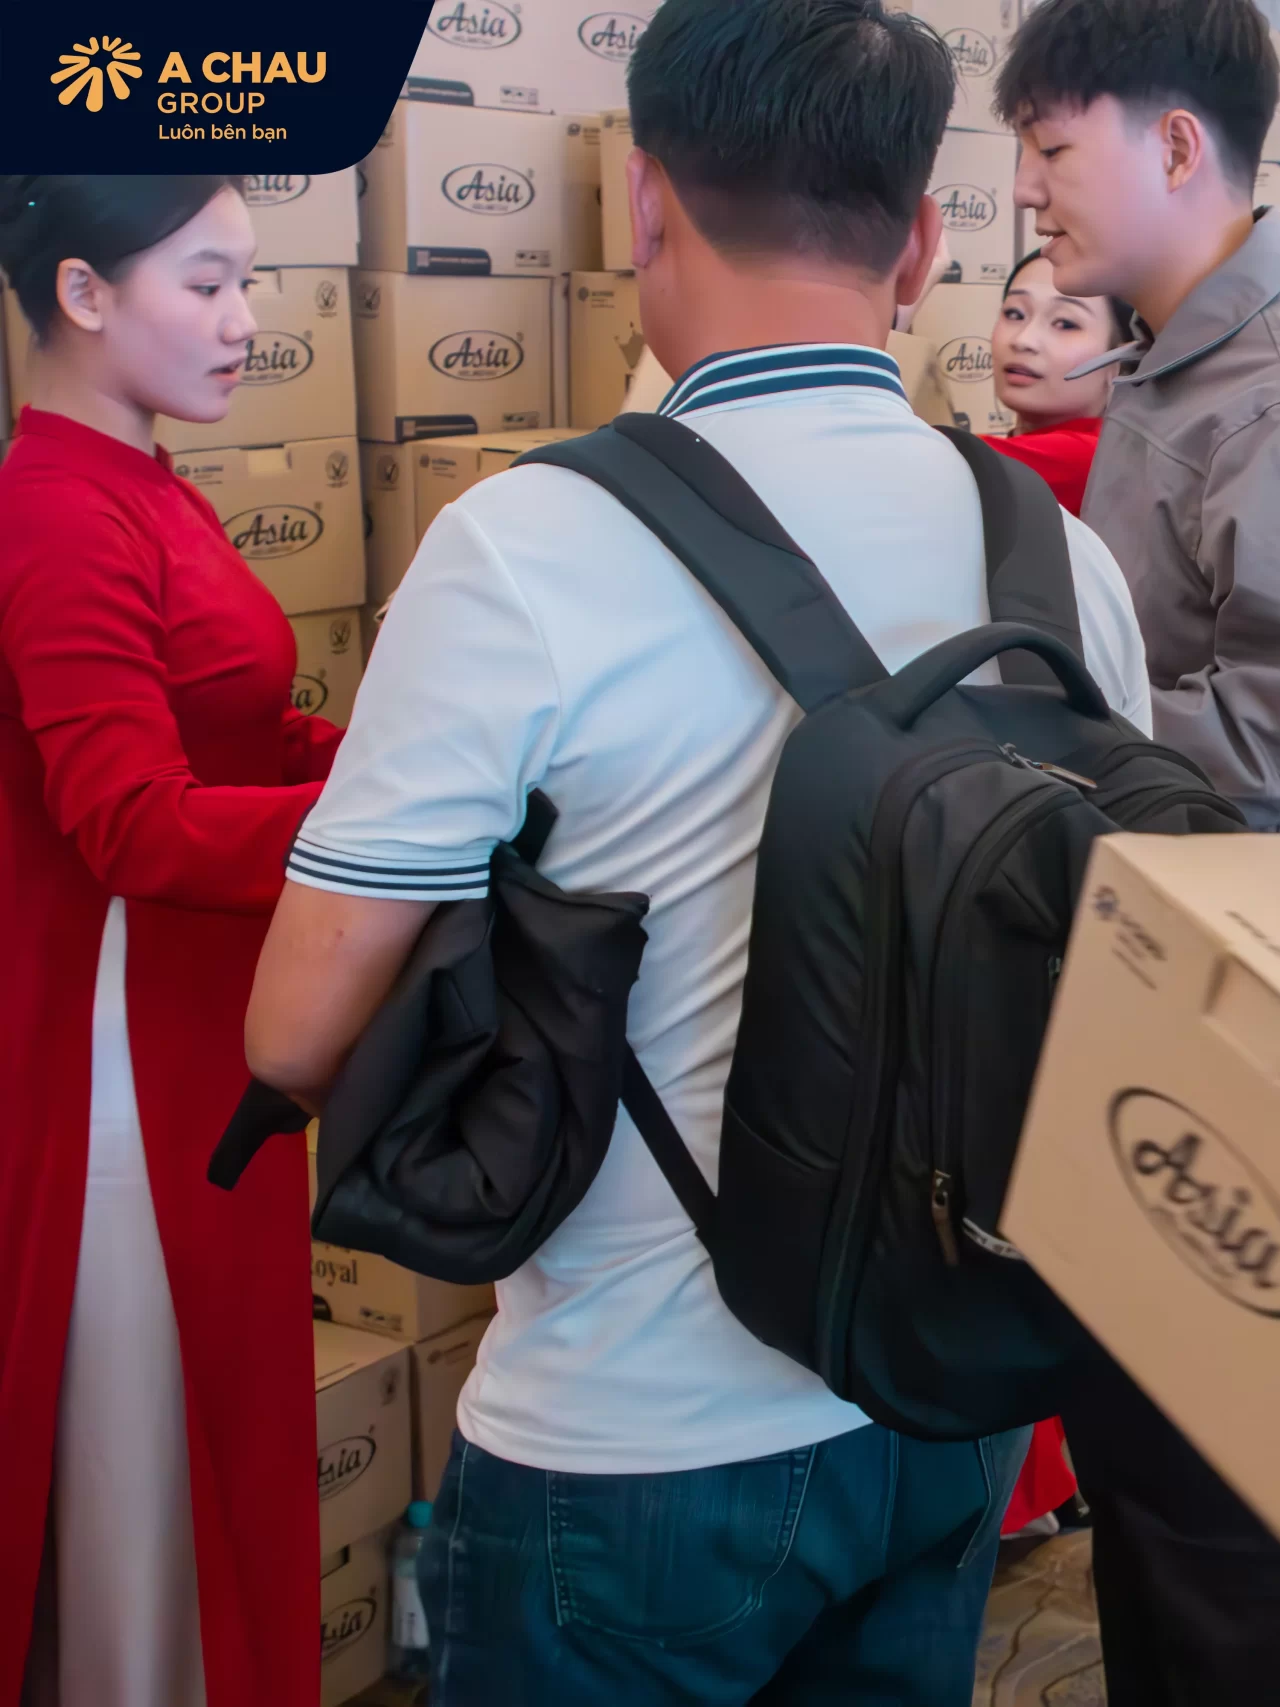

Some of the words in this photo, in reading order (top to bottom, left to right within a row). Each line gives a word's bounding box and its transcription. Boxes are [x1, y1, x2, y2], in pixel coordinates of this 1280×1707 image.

[437, 1, 506, 38] Asia
[456, 169, 522, 203] Asia
[941, 190, 987, 221] Asia
[443, 336, 512, 369] Asia
[233, 514, 310, 549] Asia
[311, 1257, 358, 1287] oyal
